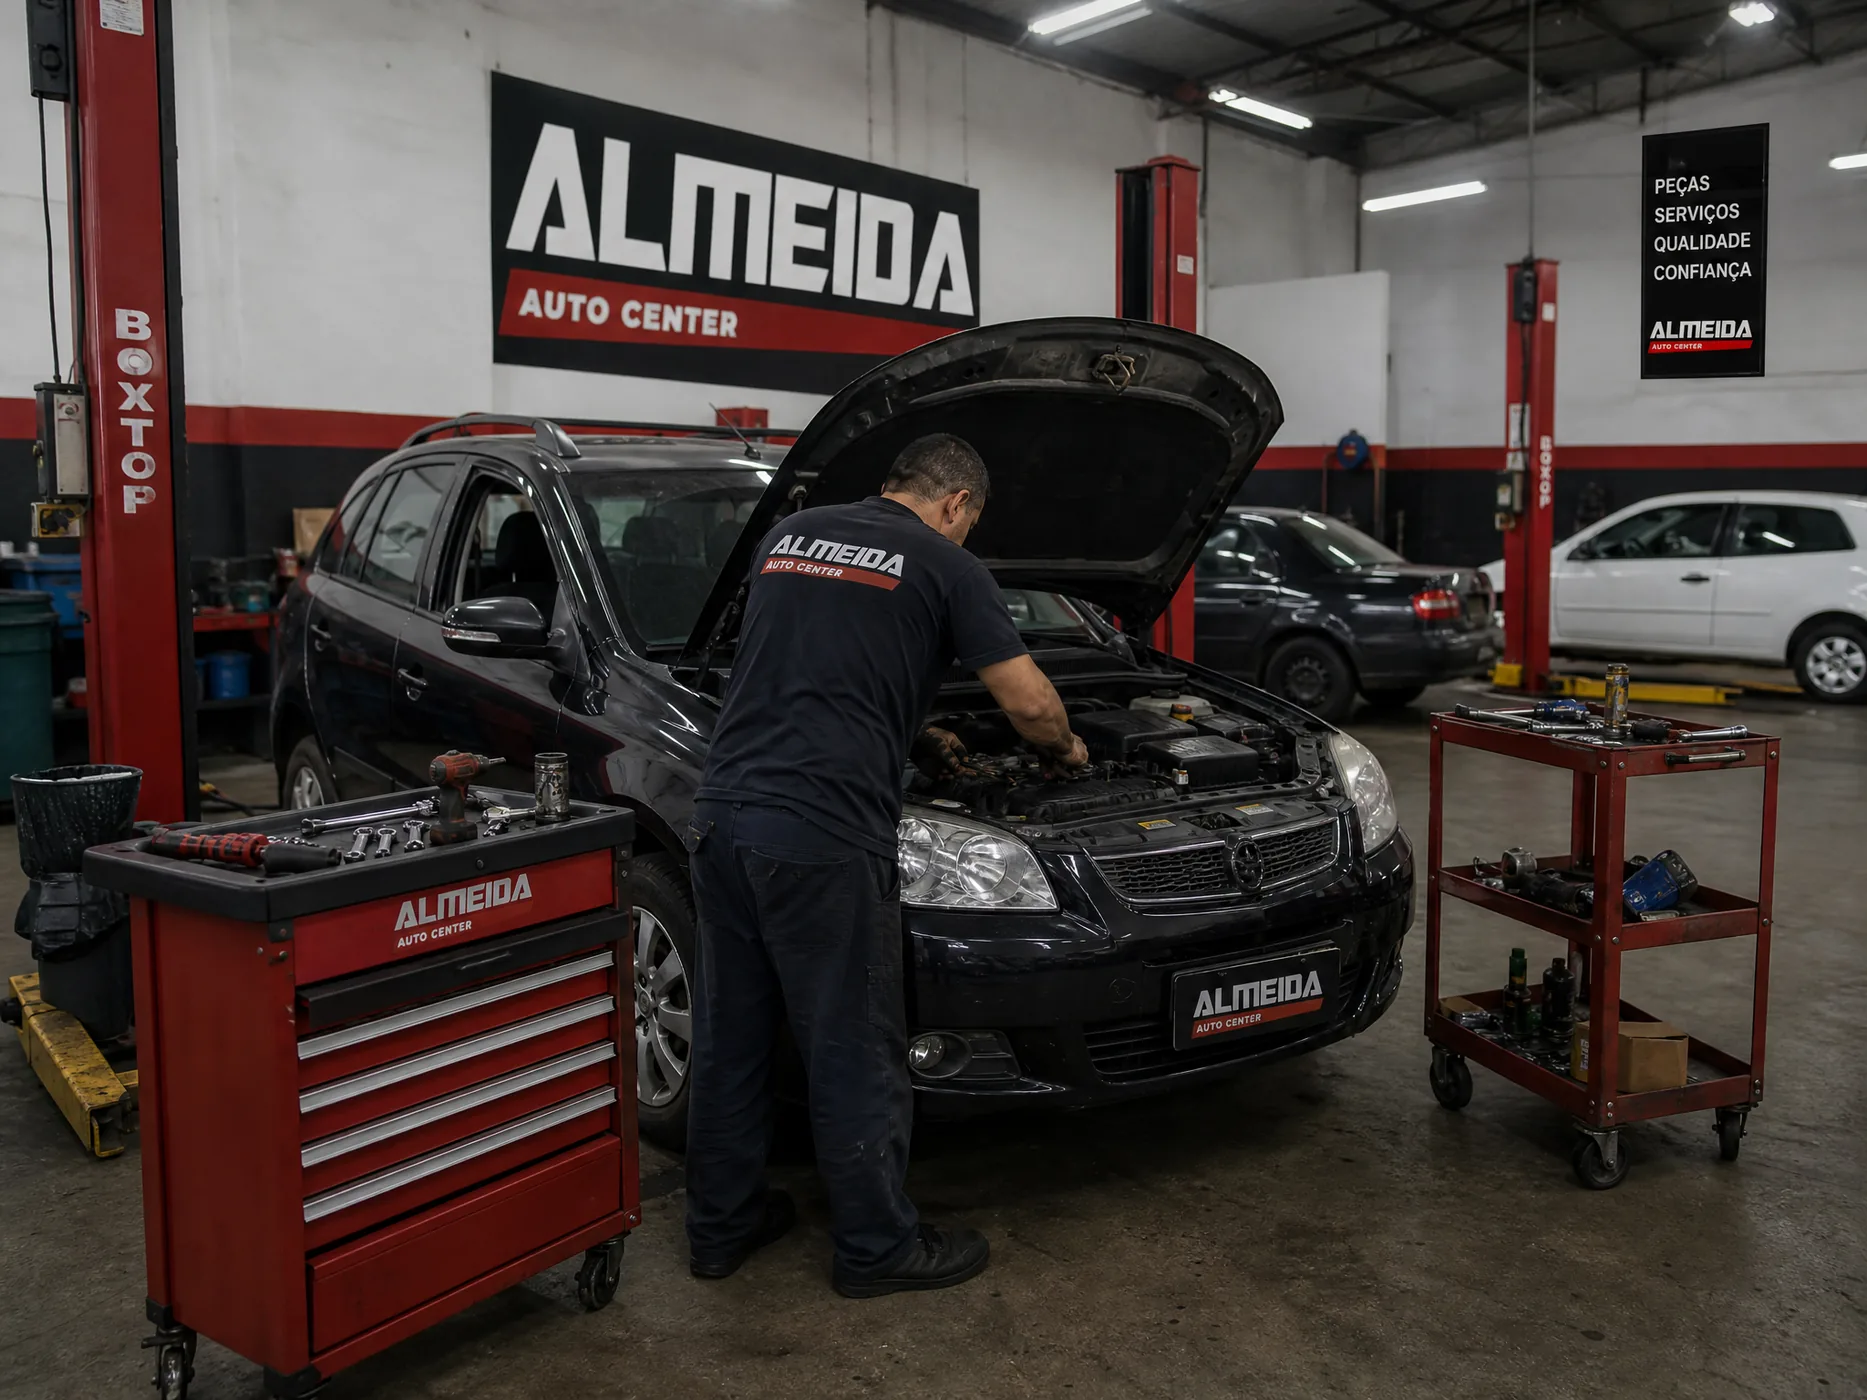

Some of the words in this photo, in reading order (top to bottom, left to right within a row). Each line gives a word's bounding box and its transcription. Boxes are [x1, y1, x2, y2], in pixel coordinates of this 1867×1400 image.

[1655, 175, 1710, 197] PEÇAS
[505, 122, 975, 316] ALMEIDA
[1654, 203, 1740, 225] SERVIÇOS
[1653, 232, 1752, 253] QUALIDADE
[1653, 262, 1752, 282] CONFIANÇA
[518, 288, 610, 325] AUTO
[621, 300, 739, 338] CENTER
[1650, 320, 1752, 339] ALMEIDA
[115, 308, 157, 514] BOXTOP
[769, 534, 905, 577] ALMEIDA
[765, 560, 794, 570] AUTO
[796, 563, 843, 577] CENTER
[394, 873, 532, 931] ALMEIDA
[397, 932, 428, 948] AUTO
[431, 920, 472, 939] CENTER
[1193, 970, 1323, 1018] ALMEIDA
[1196, 1020, 1223, 1033] AUTO
[1225, 1013, 1262, 1028] CENTER
